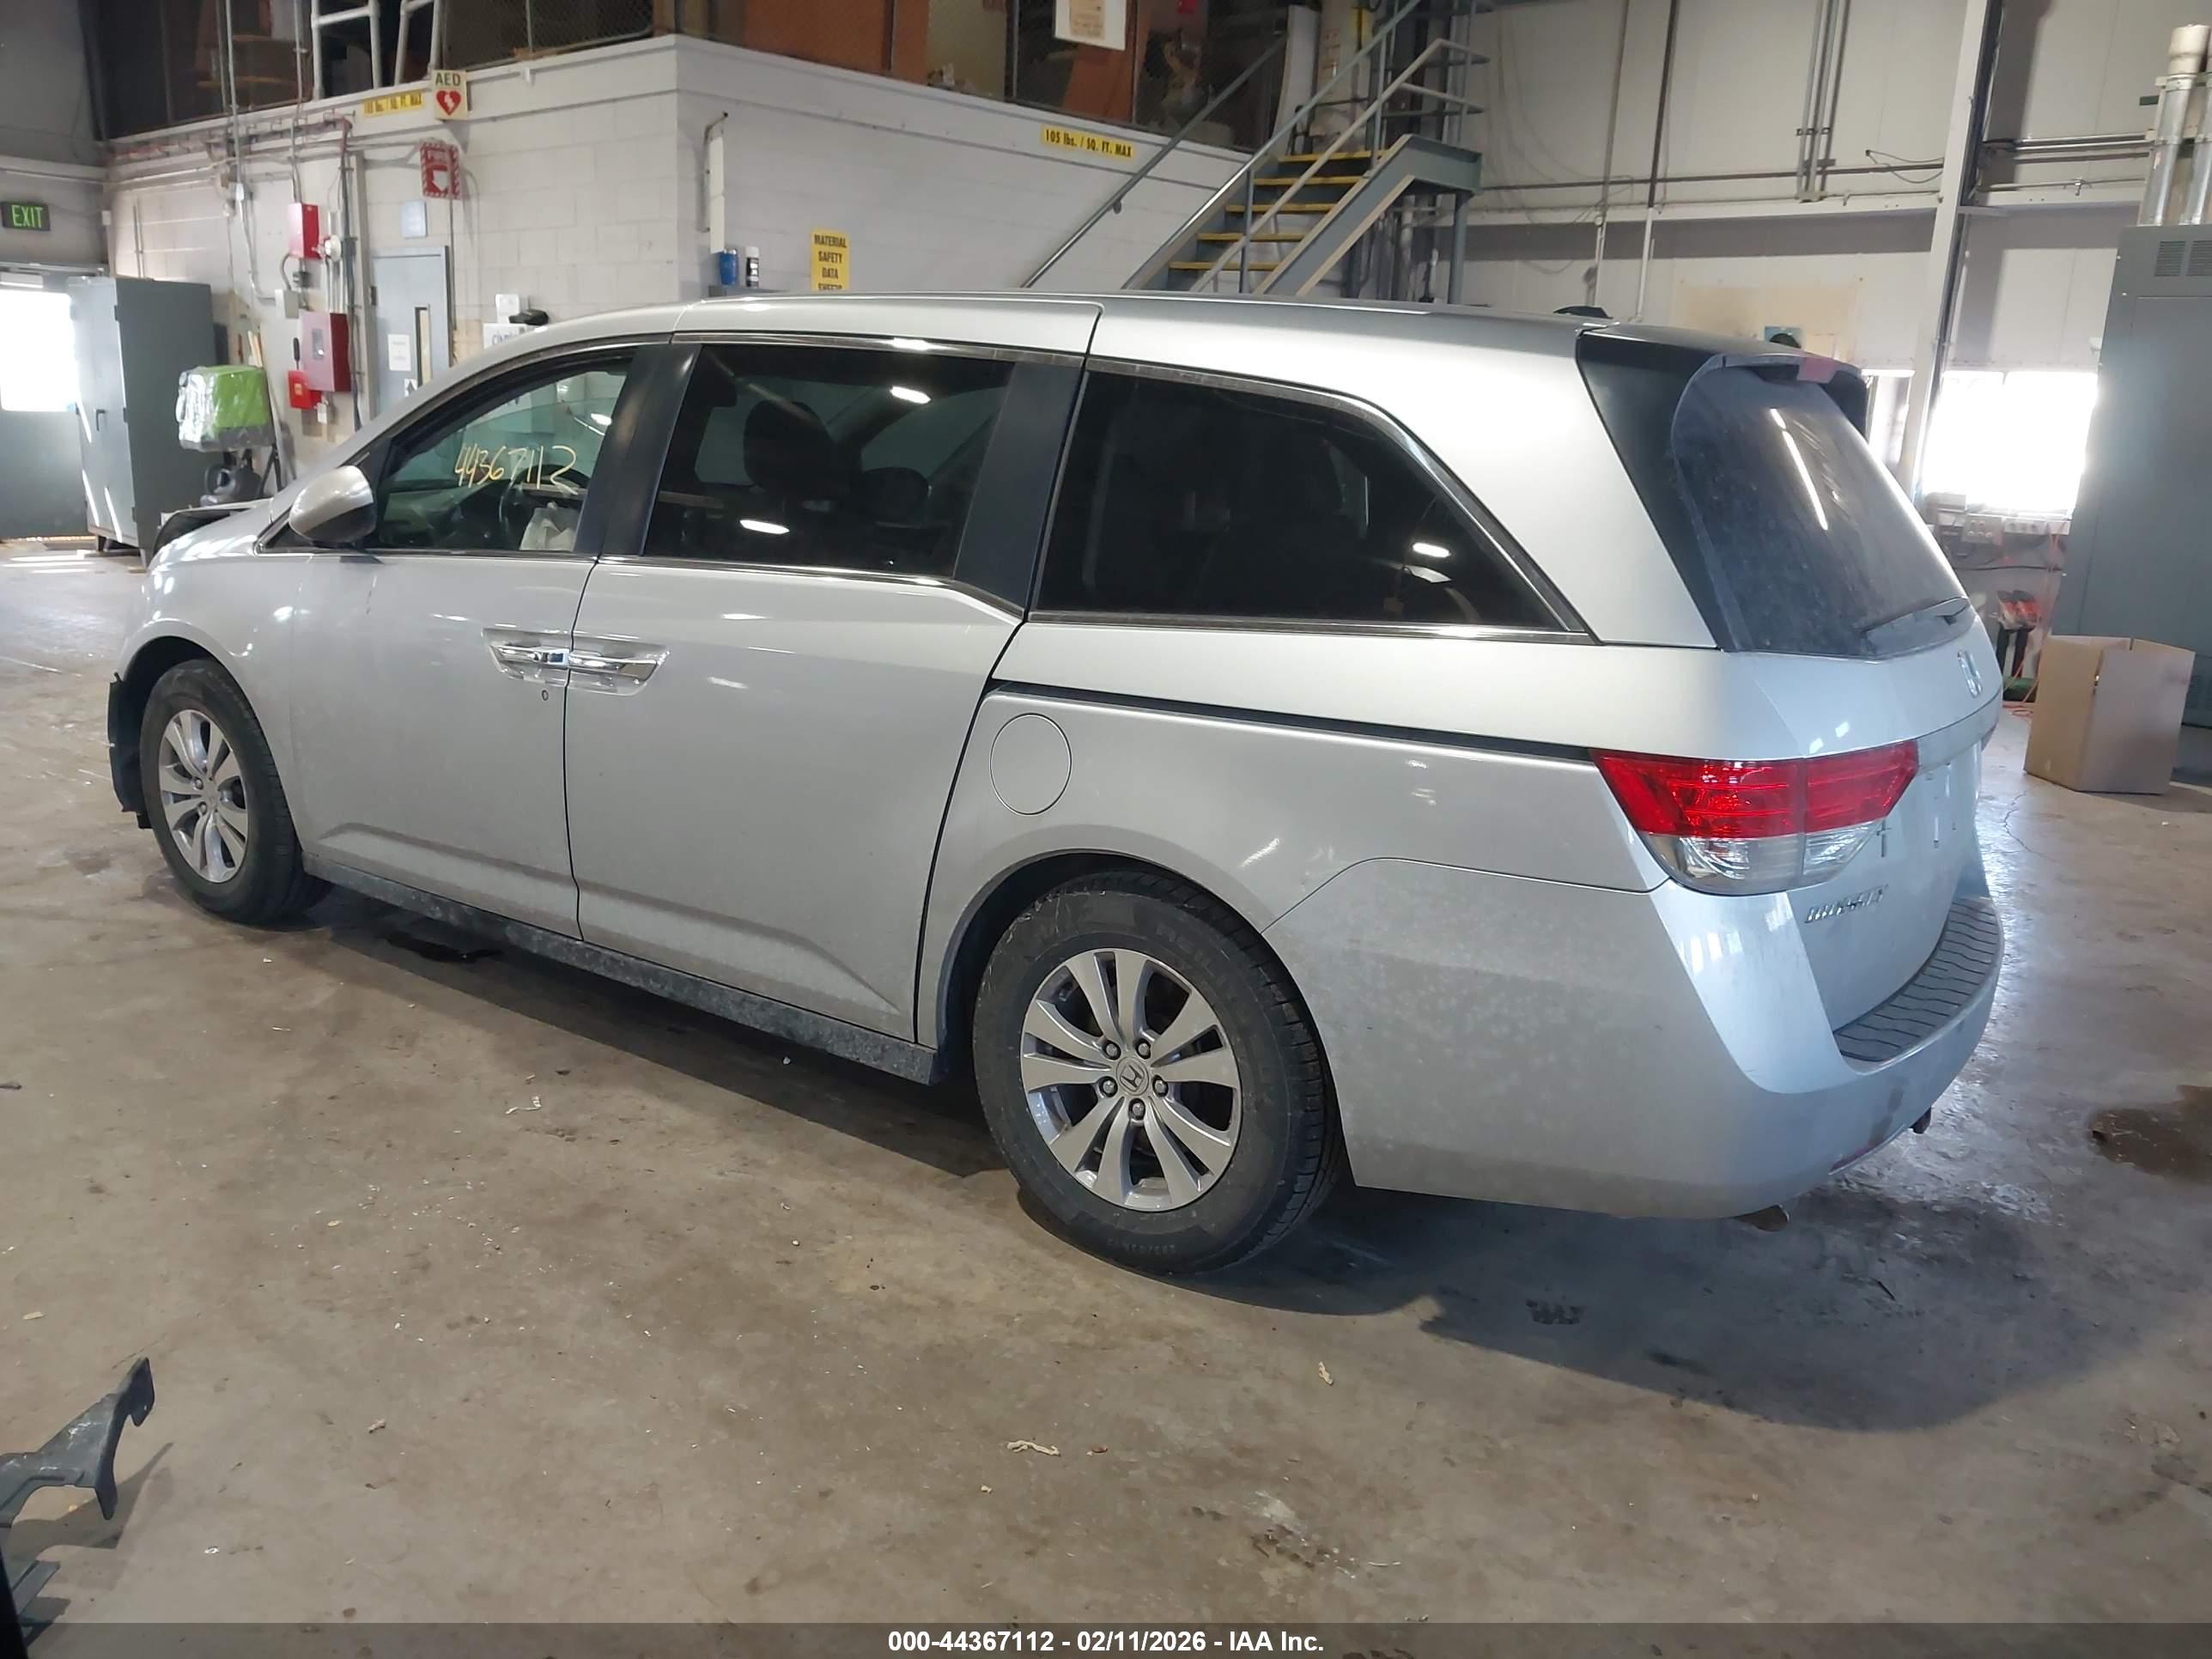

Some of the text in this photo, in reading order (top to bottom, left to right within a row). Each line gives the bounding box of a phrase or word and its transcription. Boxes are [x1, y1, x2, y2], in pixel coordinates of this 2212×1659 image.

[435, 72, 461, 87] AED
[1046, 129, 1060, 143] 105
[1115, 143, 1132, 158] MAX
[11, 204, 43, 228] EXIT
[814, 234, 847, 248] MATERIAL
[817, 251, 842, 264] SAFETY
[822, 267, 839, 279] DATA
[455, 442, 579, 495] 44367112
